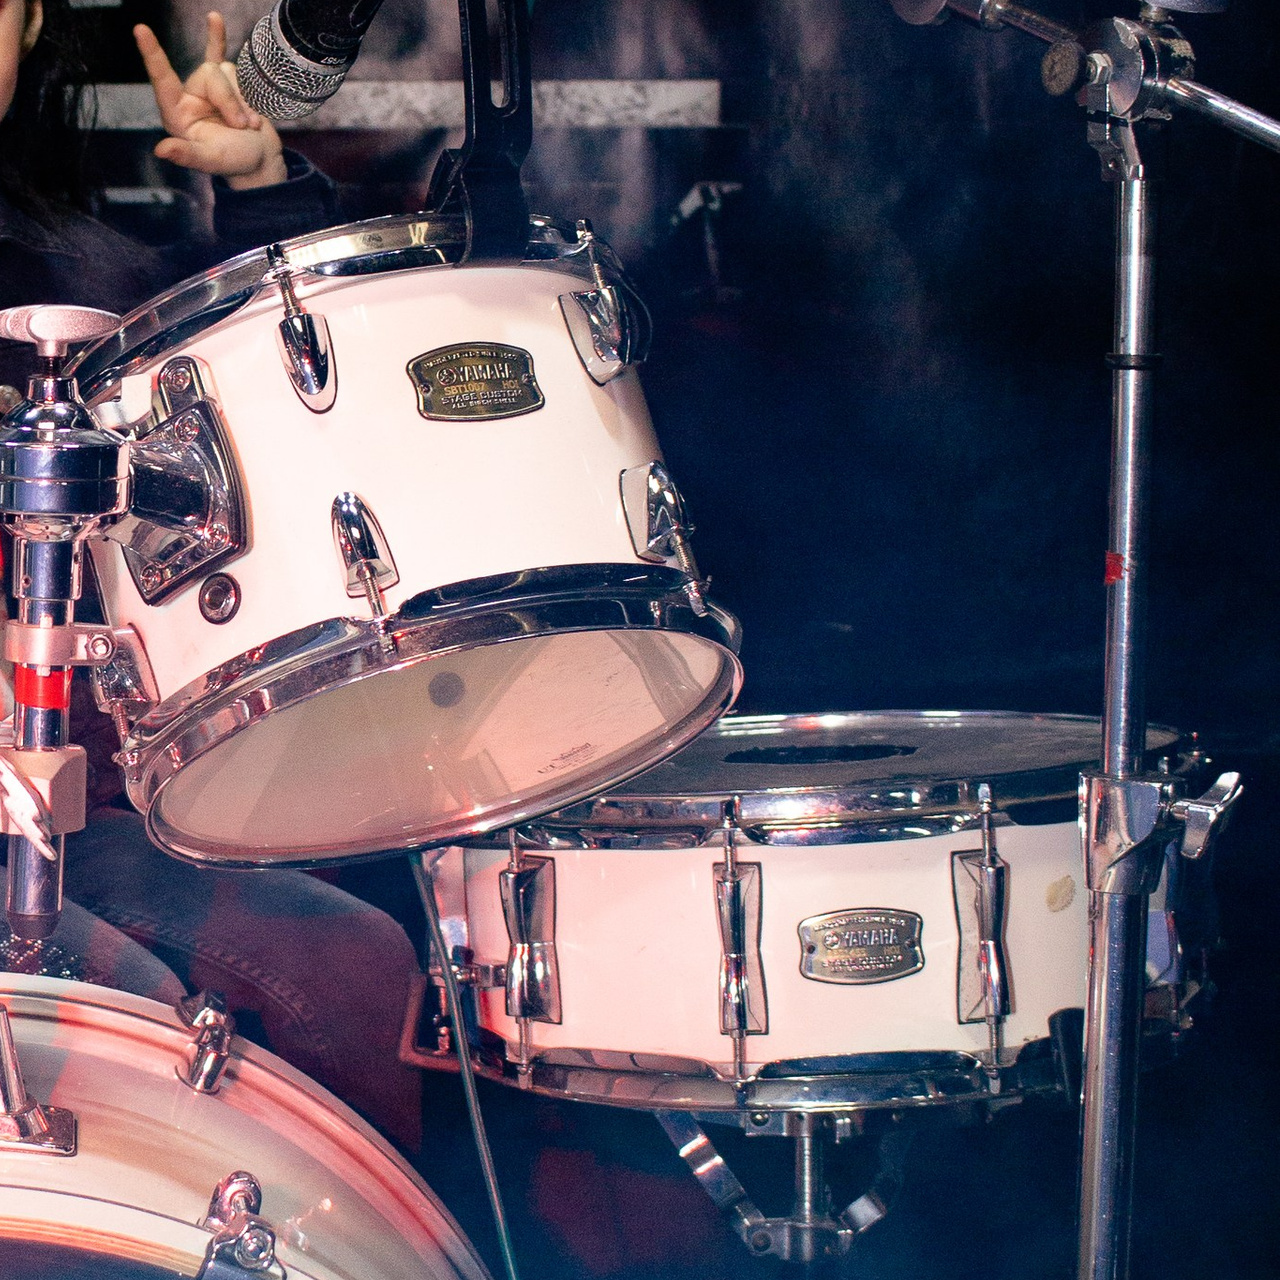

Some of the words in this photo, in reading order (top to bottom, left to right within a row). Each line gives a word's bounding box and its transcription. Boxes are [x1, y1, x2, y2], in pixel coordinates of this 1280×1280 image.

[453, 363, 515, 383] YAMAHA
[440, 392, 478, 404] STAGE
[841, 928, 899, 947] YAMAHA
